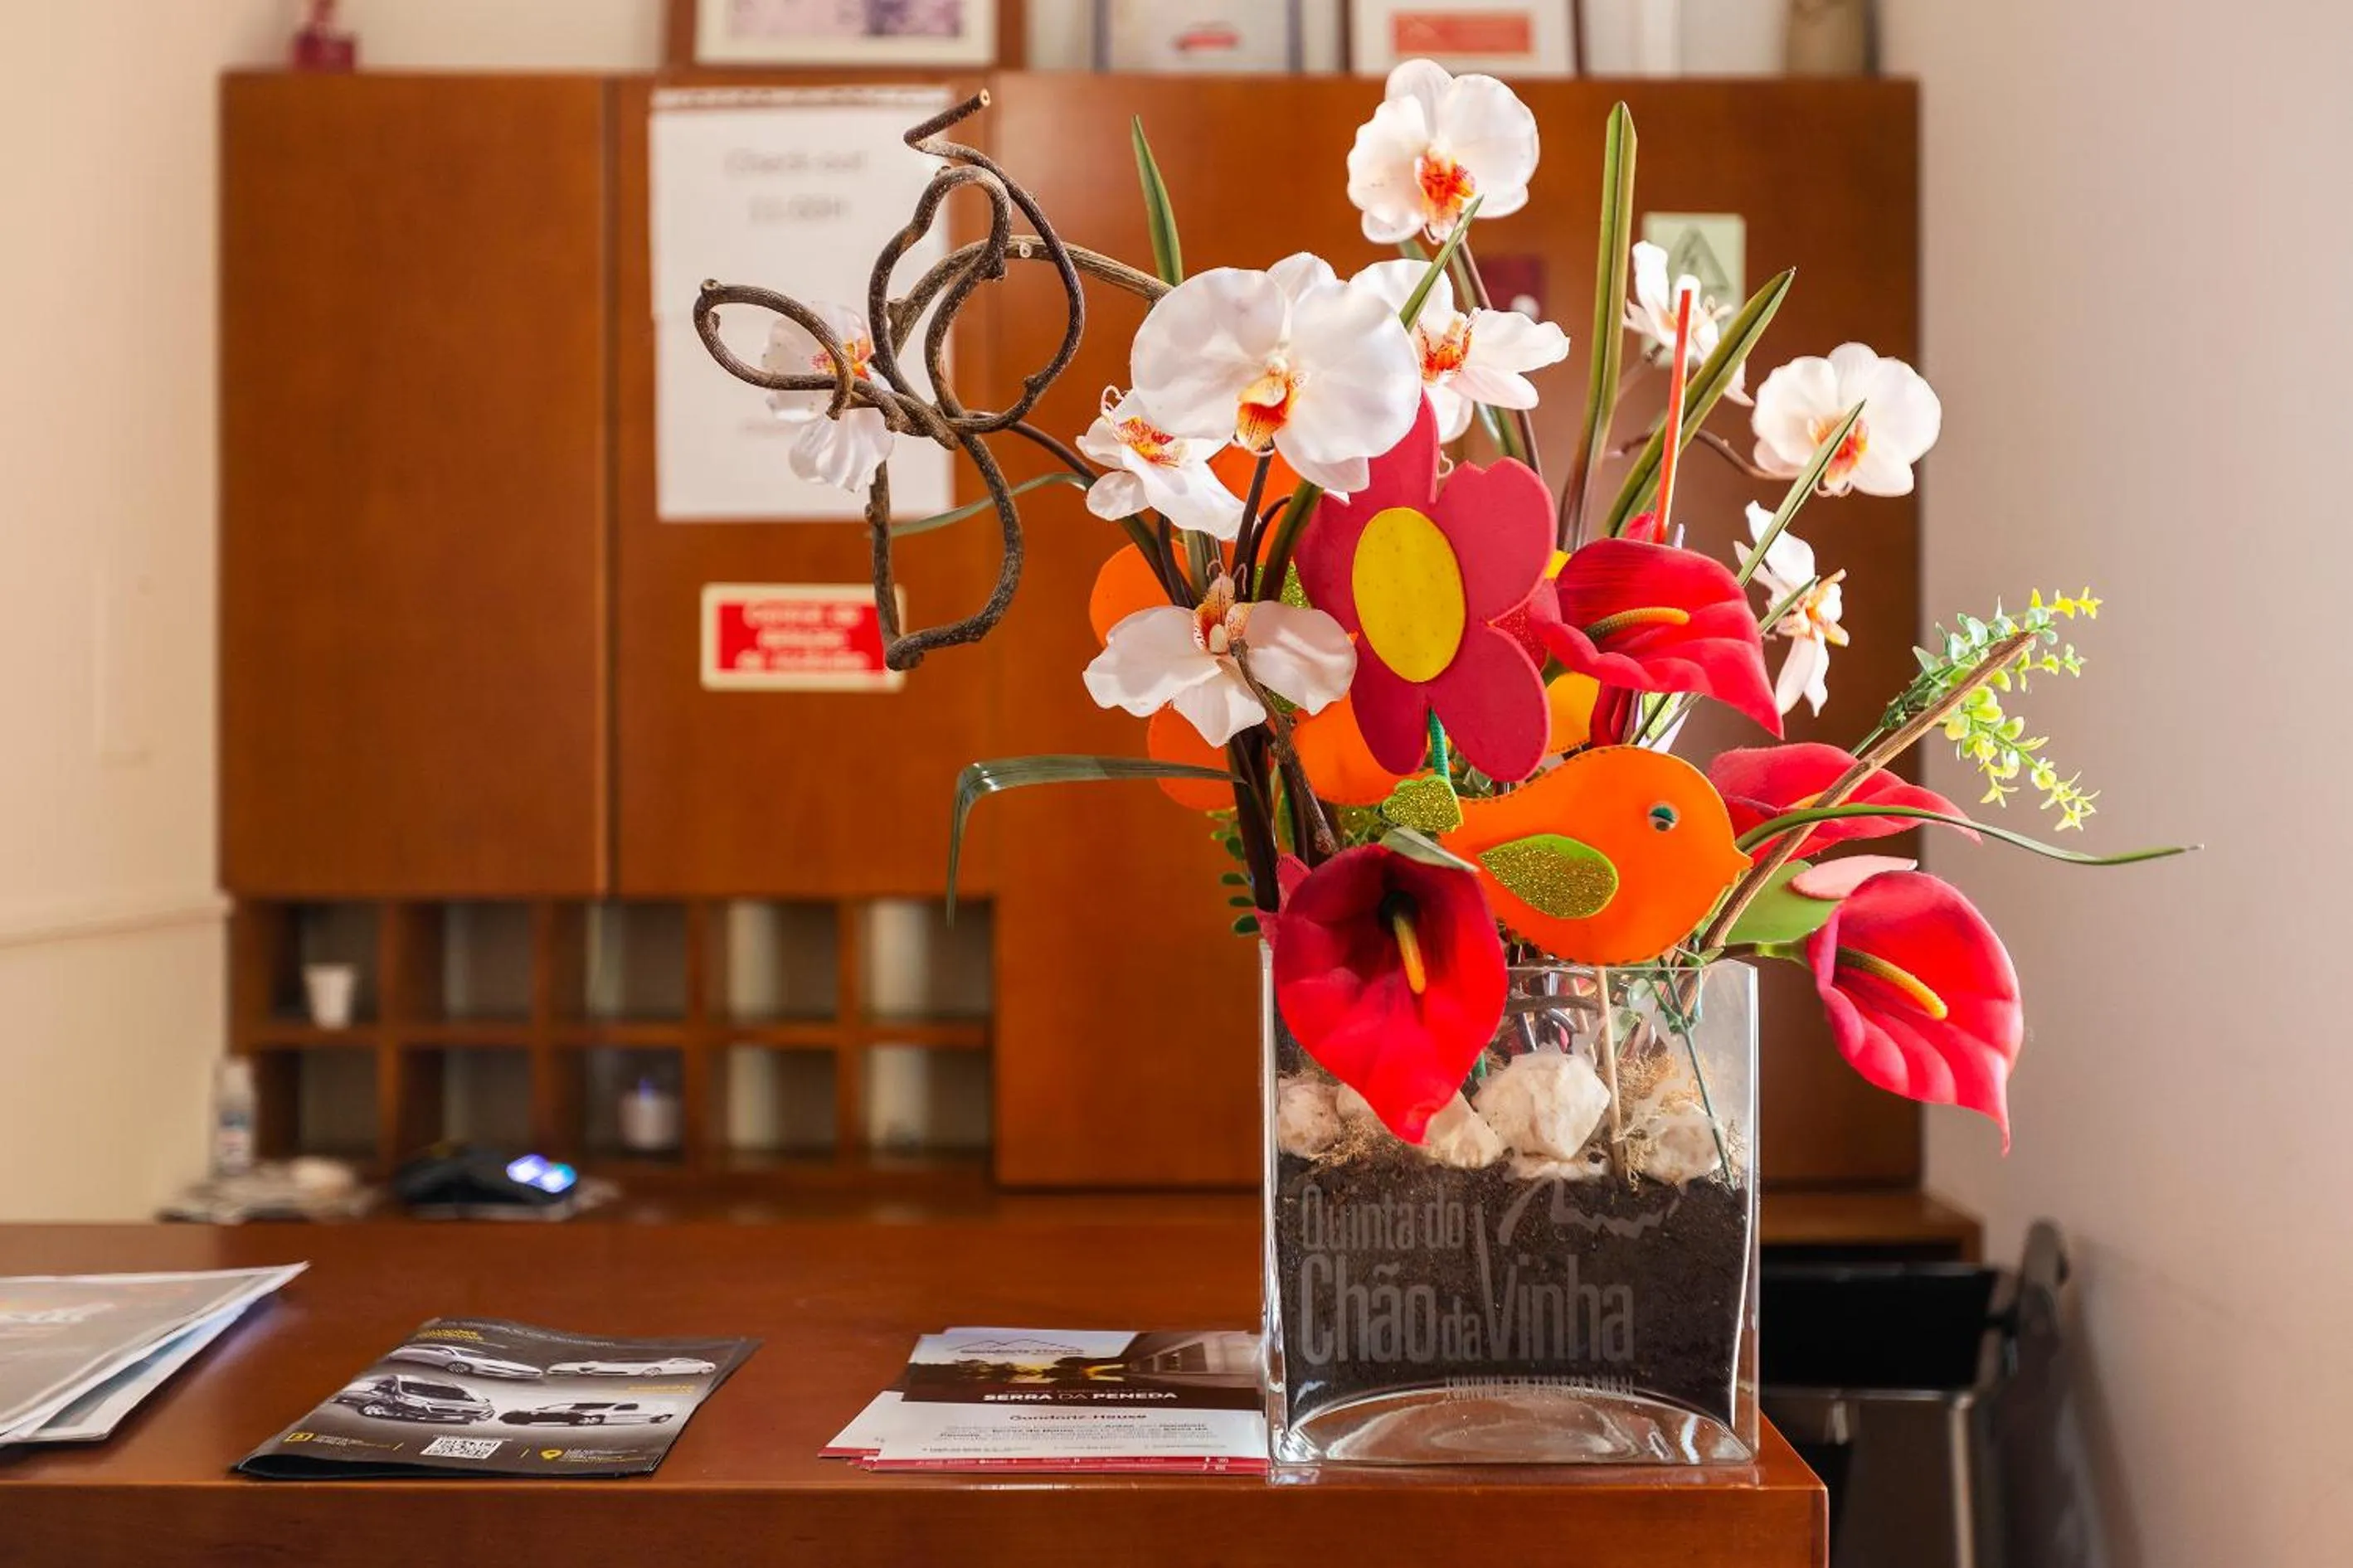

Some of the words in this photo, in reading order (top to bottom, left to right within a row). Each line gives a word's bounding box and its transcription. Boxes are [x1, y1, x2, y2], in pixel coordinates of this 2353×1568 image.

[1301, 1183, 1415, 1250] Quinta
[1424, 1191, 1466, 1250] do
[1300, 1254, 1437, 1366] Chão
[1442, 1295, 1482, 1362] da
[1475, 1204, 1635, 1362] Vinha
[982, 1393, 1053, 1401] SERRA
